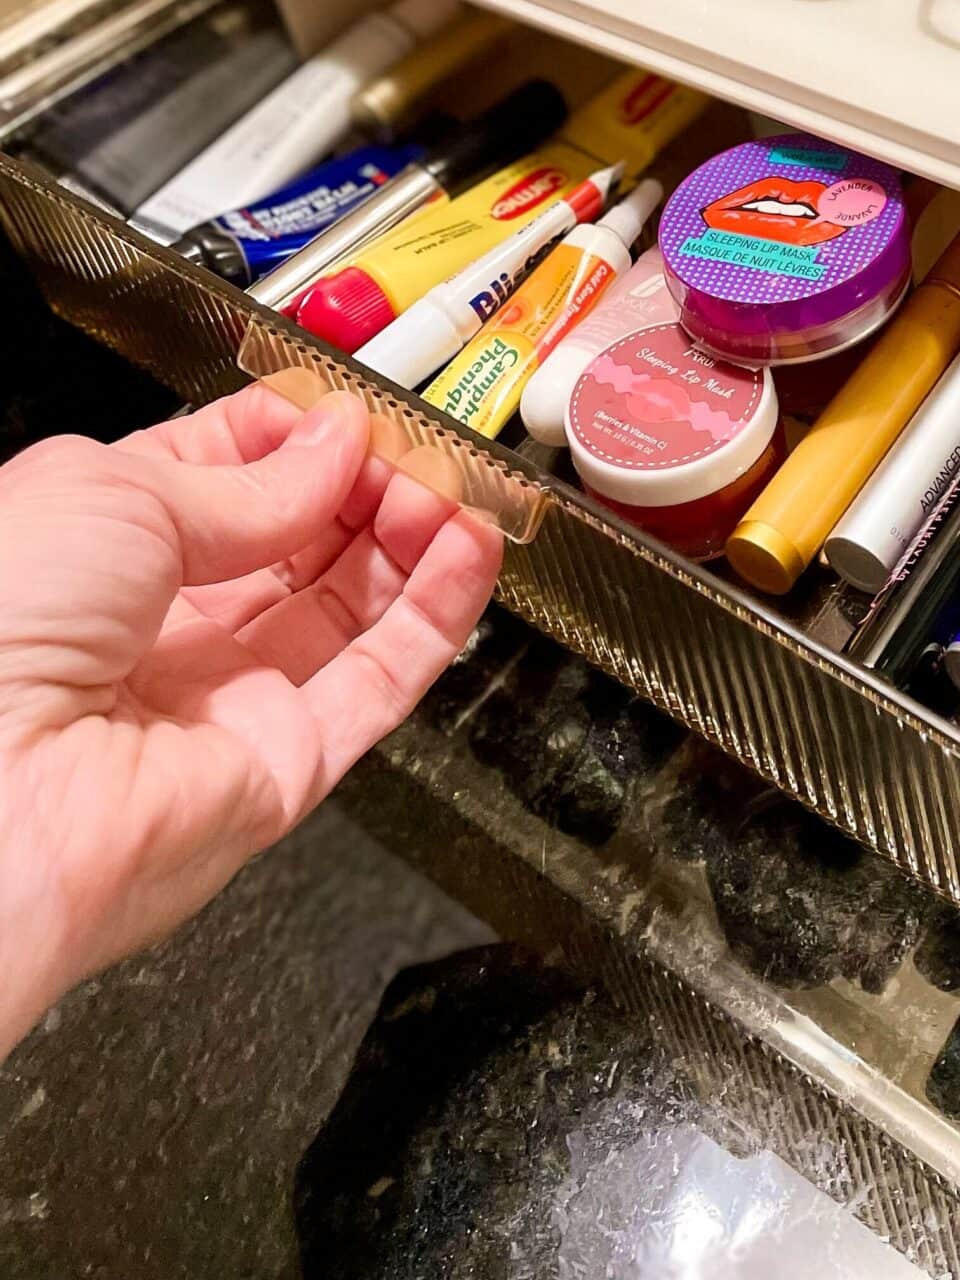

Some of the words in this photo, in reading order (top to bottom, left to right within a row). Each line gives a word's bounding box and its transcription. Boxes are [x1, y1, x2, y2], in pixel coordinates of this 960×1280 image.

[828, 182, 873, 202] LAVENDER
[835, 204, 878, 221] LAVANDE
[683, 241, 733, 261] MASQUE
[734, 251, 748, 264] DE
[750, 255, 776, 270] NUIT
[707, 232, 759, 251] SLEEPING
[761, 241, 780, 254] LIP
[780, 244, 814, 262] MASK
[574, 282, 594, 306] Sore
[635, 347, 679, 375] Sleeping
[680, 370, 701, 385] Lip
[702, 378, 737, 399] Mask
